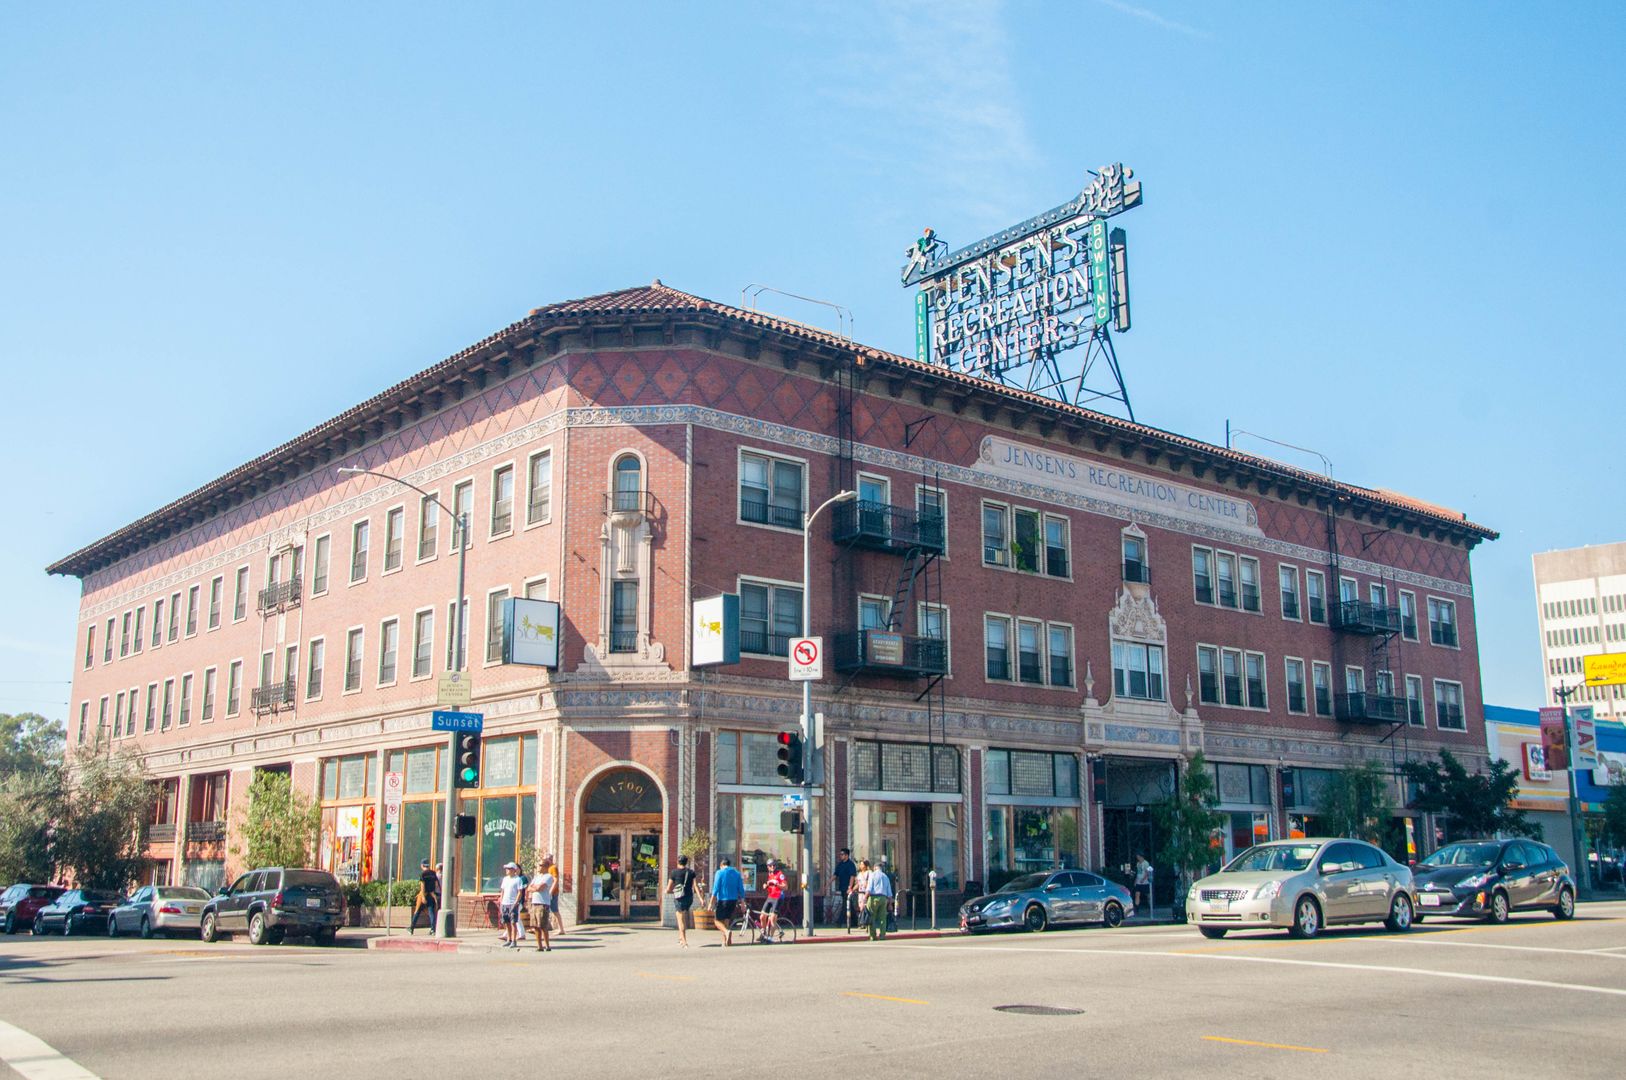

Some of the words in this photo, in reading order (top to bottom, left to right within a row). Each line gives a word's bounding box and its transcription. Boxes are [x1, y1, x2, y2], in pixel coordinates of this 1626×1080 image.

[937, 225, 1078, 310] JENSEN'S
[1093, 224, 1107, 319] BOWLING
[933, 263, 1090, 349] RECREATION
[959, 315, 1062, 374] CENTER
[1003, 446, 1076, 480] JENSEN'S
[1088, 466, 1177, 504] RECREATION
[1187, 490, 1239, 519] CENTER
[437, 715, 479, 728] Sunset
[610, 781, 643, 794] 1700
